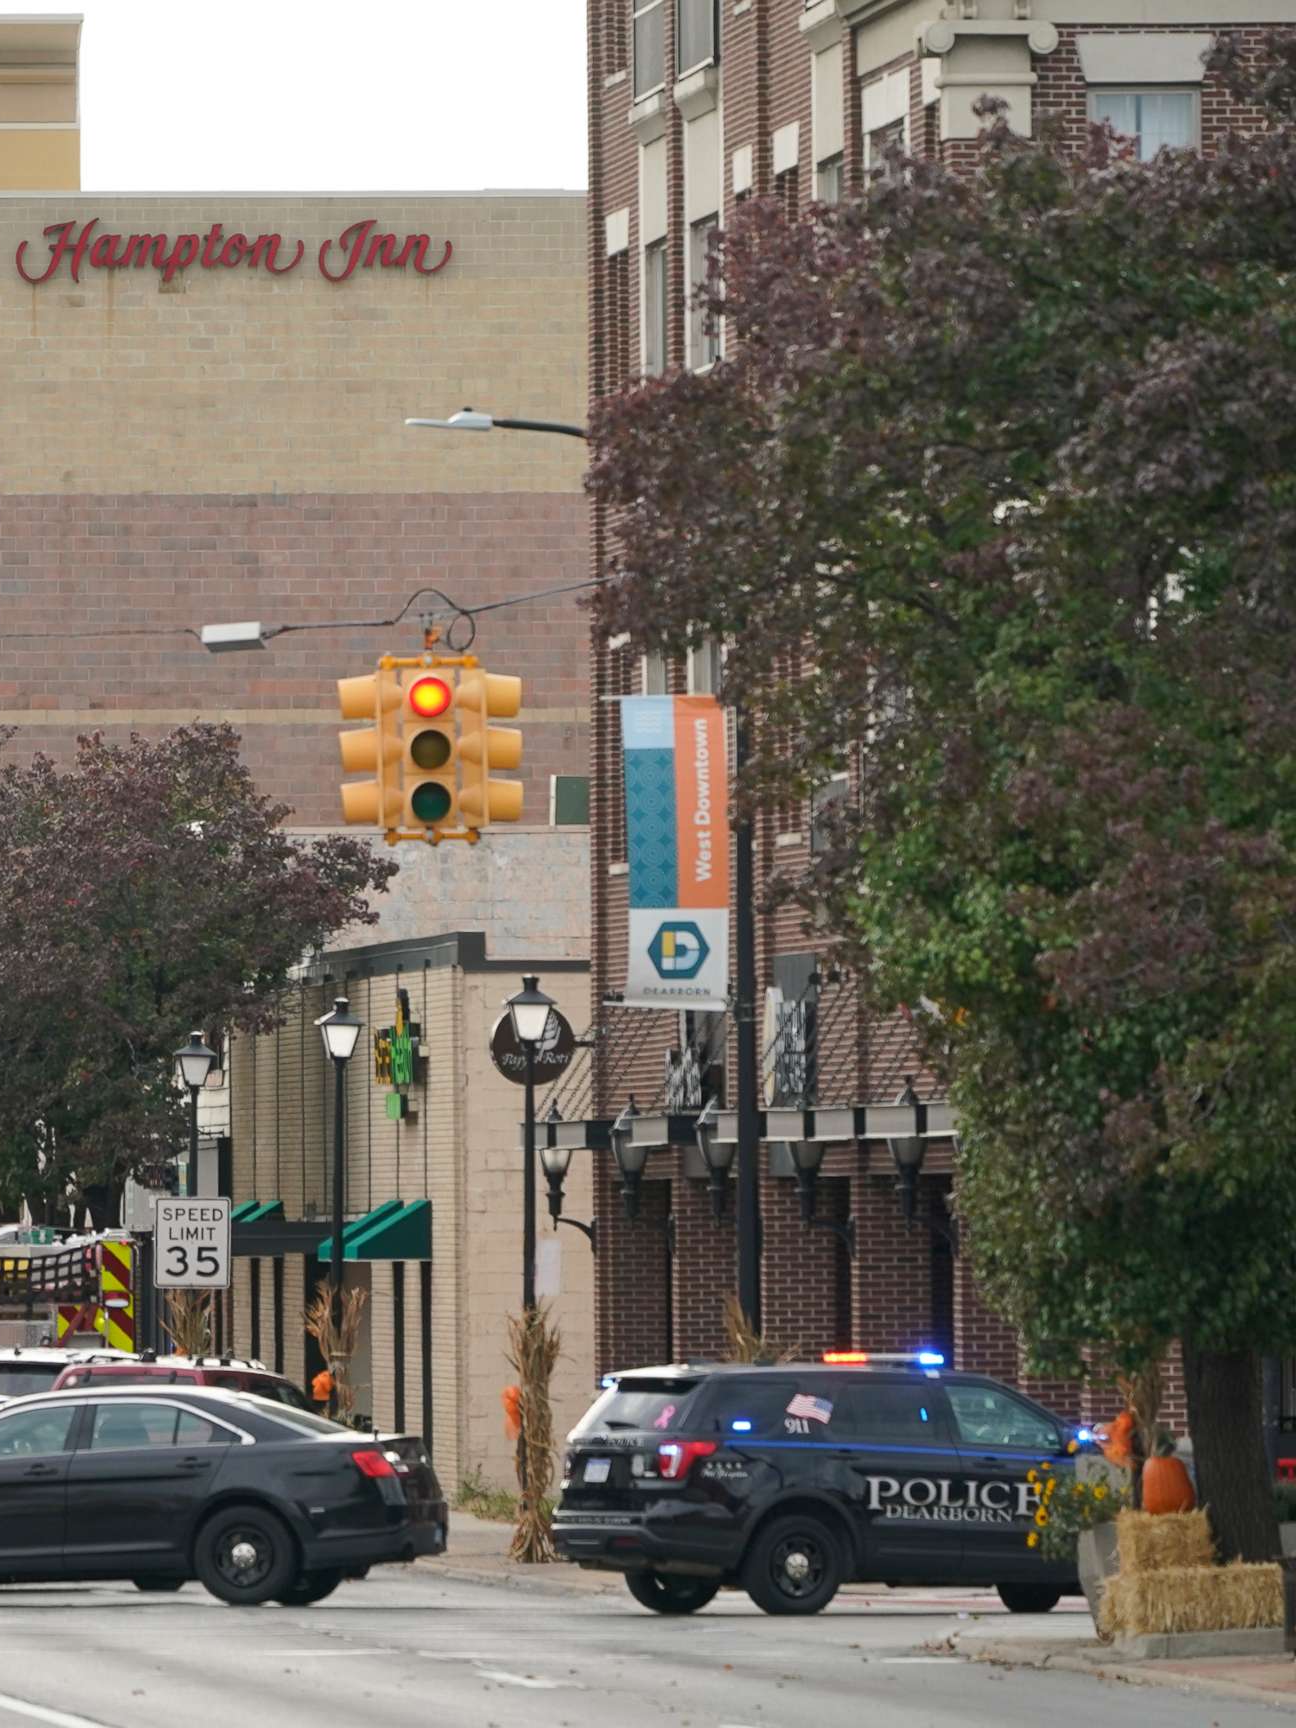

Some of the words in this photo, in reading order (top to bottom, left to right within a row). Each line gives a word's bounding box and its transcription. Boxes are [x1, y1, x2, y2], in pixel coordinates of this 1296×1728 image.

[15, 217, 304, 284] Hampton
[318, 219, 453, 282] Inn
[693, 718, 711, 826] Downtown
[695, 831, 712, 882] West
[643, 987, 711, 995] DEARBORN
[162, 1207, 224, 1222] SPEED
[168, 1226, 216, 1241] LIMIT
[165, 1246, 220, 1278] 35
[784, 1417, 811, 1434] 911
[864, 1475, 1042, 1517] POLICE
[885, 1503, 1013, 1523] DEARBORN
